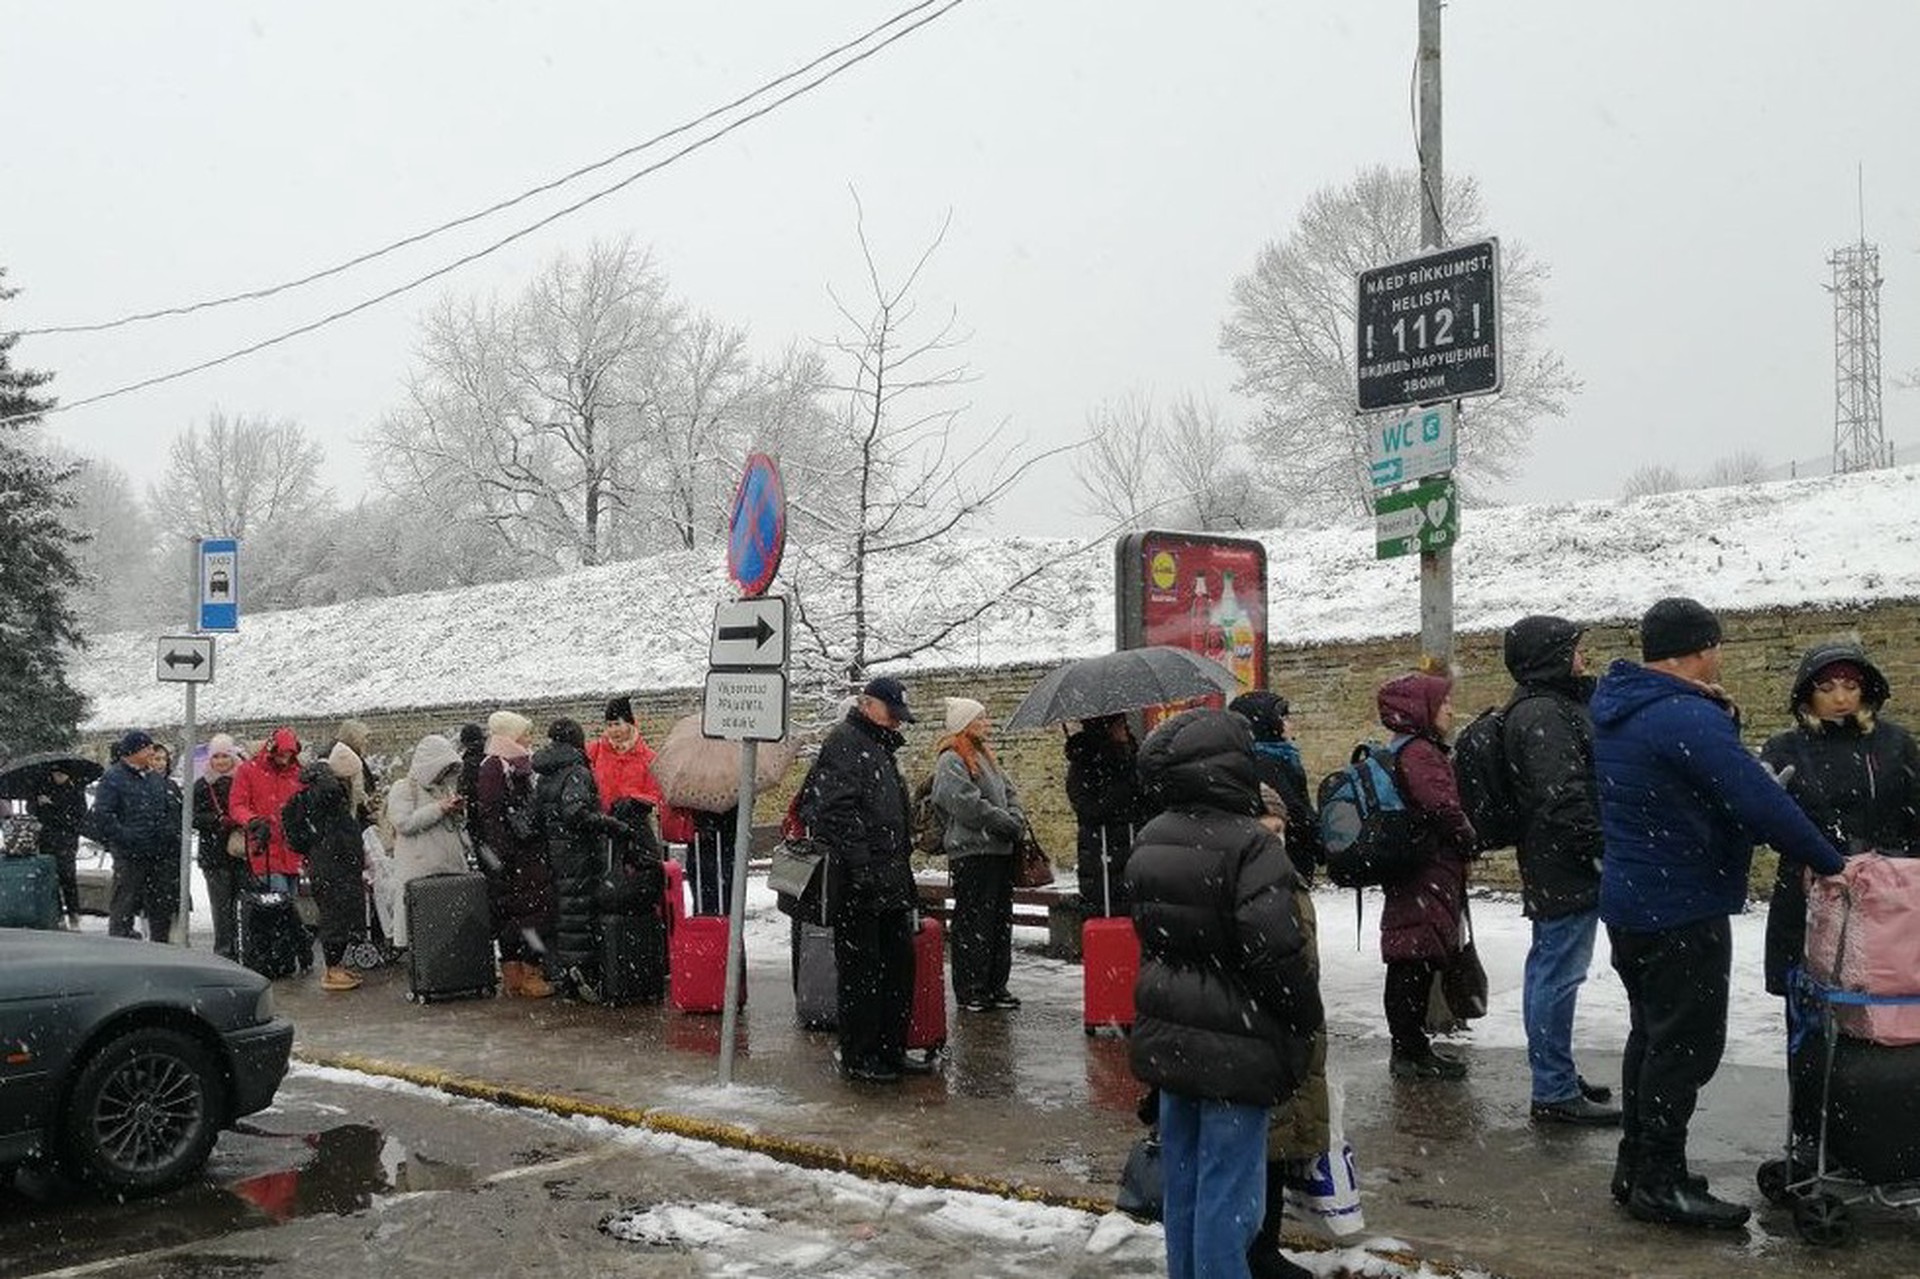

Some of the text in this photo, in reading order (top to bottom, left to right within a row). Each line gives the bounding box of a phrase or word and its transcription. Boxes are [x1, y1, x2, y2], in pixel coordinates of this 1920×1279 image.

[1391, 288, 1451, 313] HELISTA
[1391, 307, 1455, 352] 112
[1402, 375, 1446, 394] ЗВОНИ
[1382, 420, 1414, 452] WC
